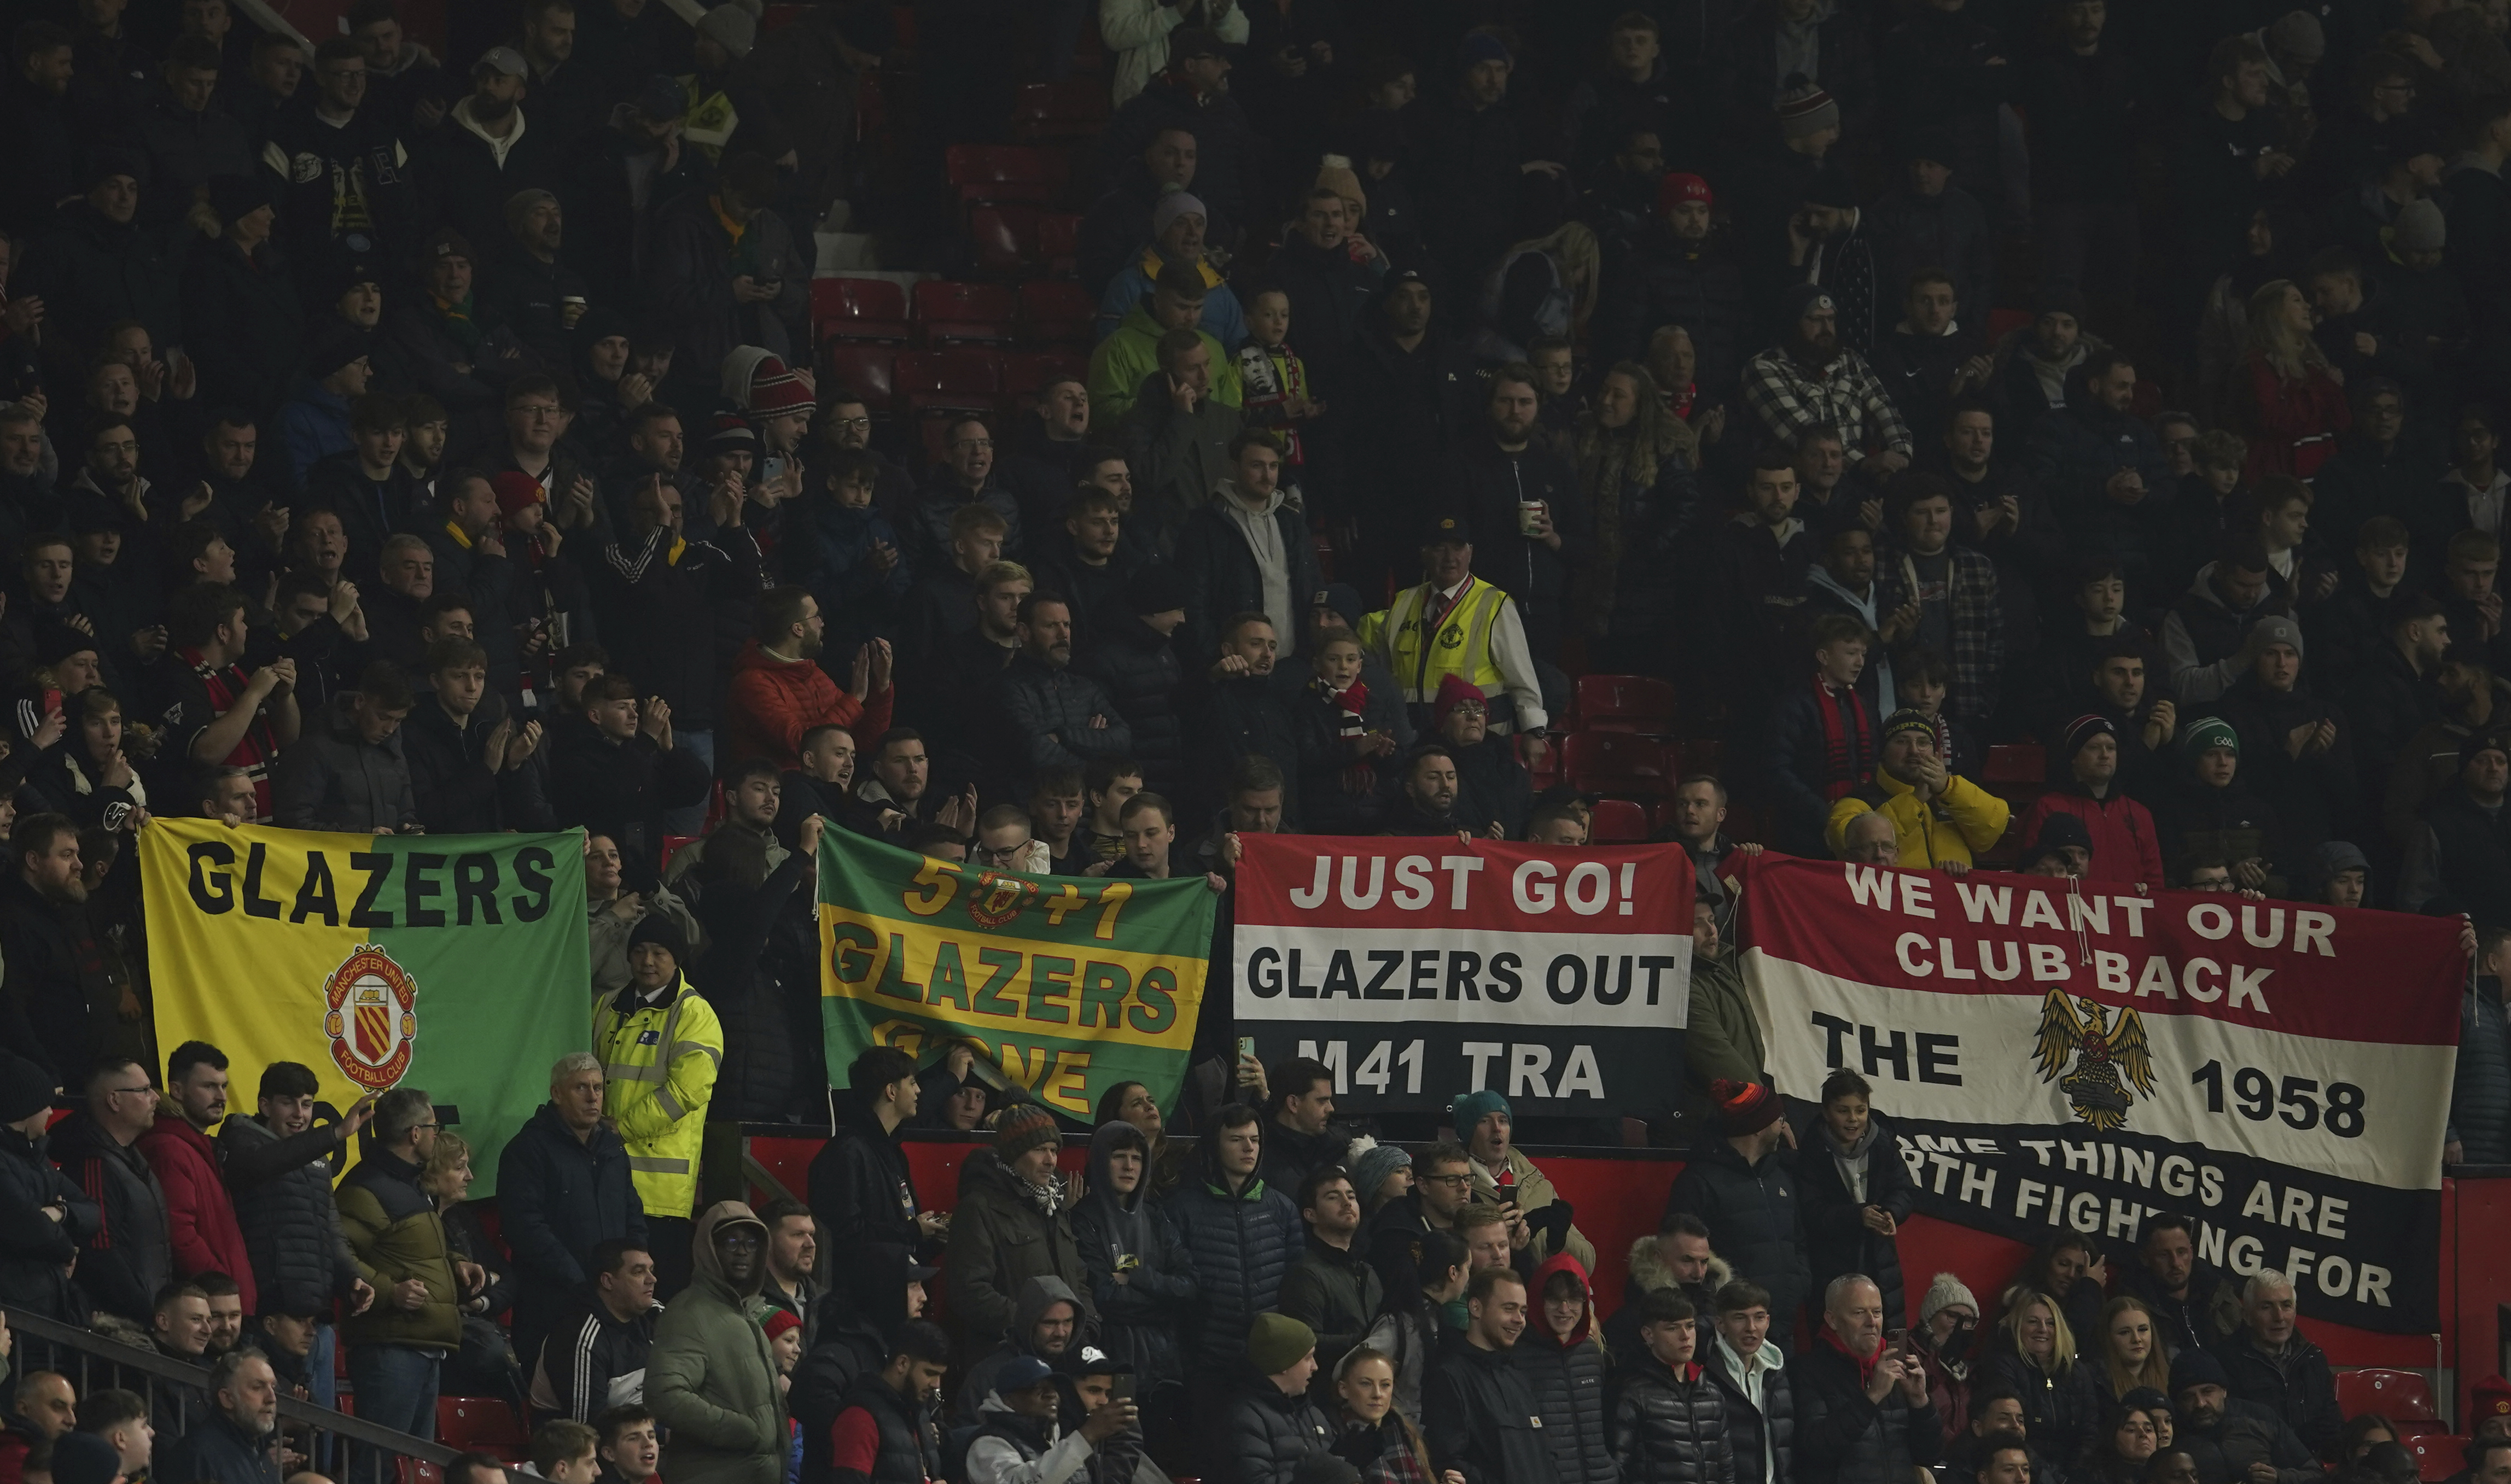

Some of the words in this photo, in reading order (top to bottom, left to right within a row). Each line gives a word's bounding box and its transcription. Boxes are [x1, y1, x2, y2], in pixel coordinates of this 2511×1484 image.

[187, 841, 556, 928] GLAZERS
[903, 855, 963, 916] 5
[970, 904, 996, 924] FOOTBALL
[998, 910, 1017, 924] CLUB
[1289, 855, 1484, 910] JUST
[1512, 860, 1636, 916] GO!
[1844, 862, 1936, 920] WE
[1954, 881, 2155, 938] WANT
[2187, 902, 2337, 957] OUR
[331, 958, 383, 1004] MANCHESTER
[384, 965, 409, 1004] UNITED
[831, 922, 1178, 1035] GLAZERS
[1247, 946, 1523, 1003] GLAZERS
[1546, 954, 1674, 1006] OUT
[1895, 931, 2072, 982] CLUB
[2094, 949, 2275, 1014] BACK
[341, 1050, 386, 1083] FOOTBALL
[386, 1051, 406, 1079] CLUB
[872, 1018, 1092, 1114] GNE
[1298, 1039, 1425, 1095] M41
[1462, 1042, 1606, 1099] TRA
[1811, 1010, 1962, 1087] THE
[2192, 1059, 2366, 1139] 1958
[2019, 1139, 2225, 1207] THINGS
[2242, 1179, 2349, 1240] ARE
[2015, 1178, 2265, 1278] FIGHNG
[2285, 1246, 2392, 1308] FOR
